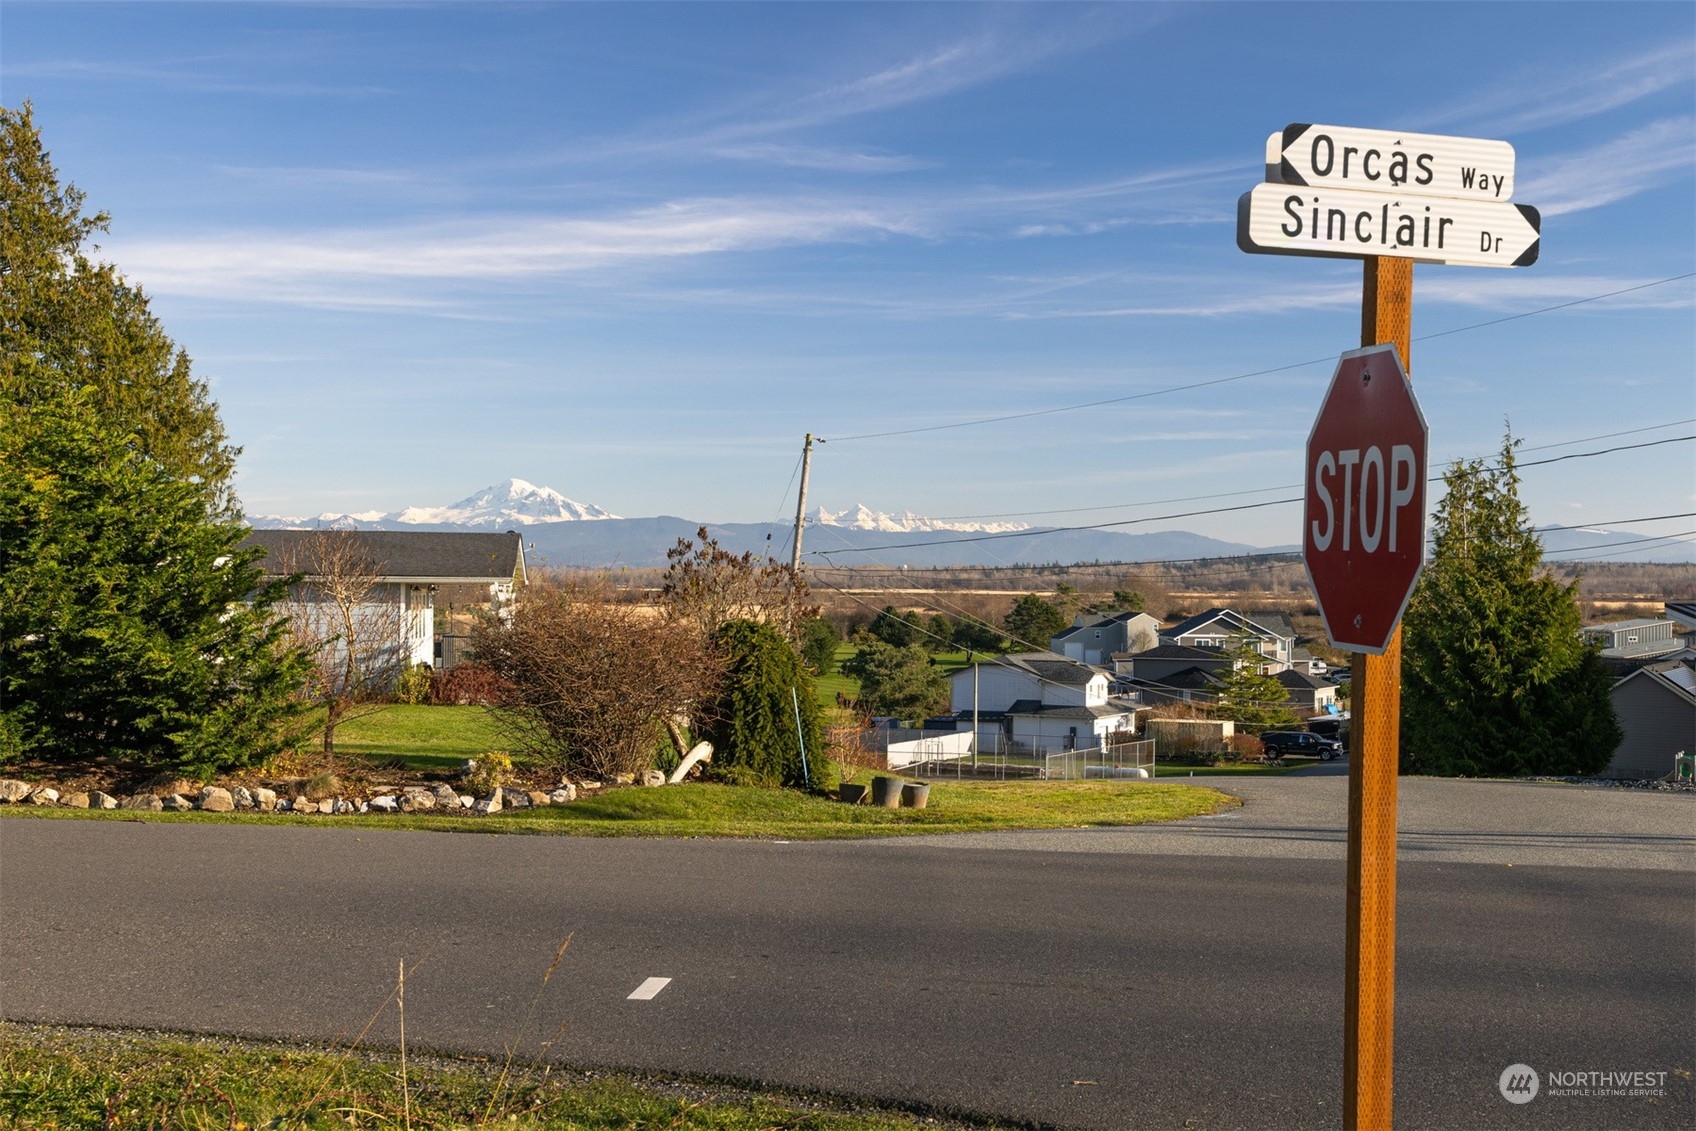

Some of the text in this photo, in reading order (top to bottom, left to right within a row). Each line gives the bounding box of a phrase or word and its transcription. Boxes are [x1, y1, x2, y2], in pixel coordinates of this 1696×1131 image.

[1311, 134, 1504, 198] Orcas Way
[1281, 195, 1503, 254] Sinclair Dr
[1312, 444, 1416, 553] STOP
